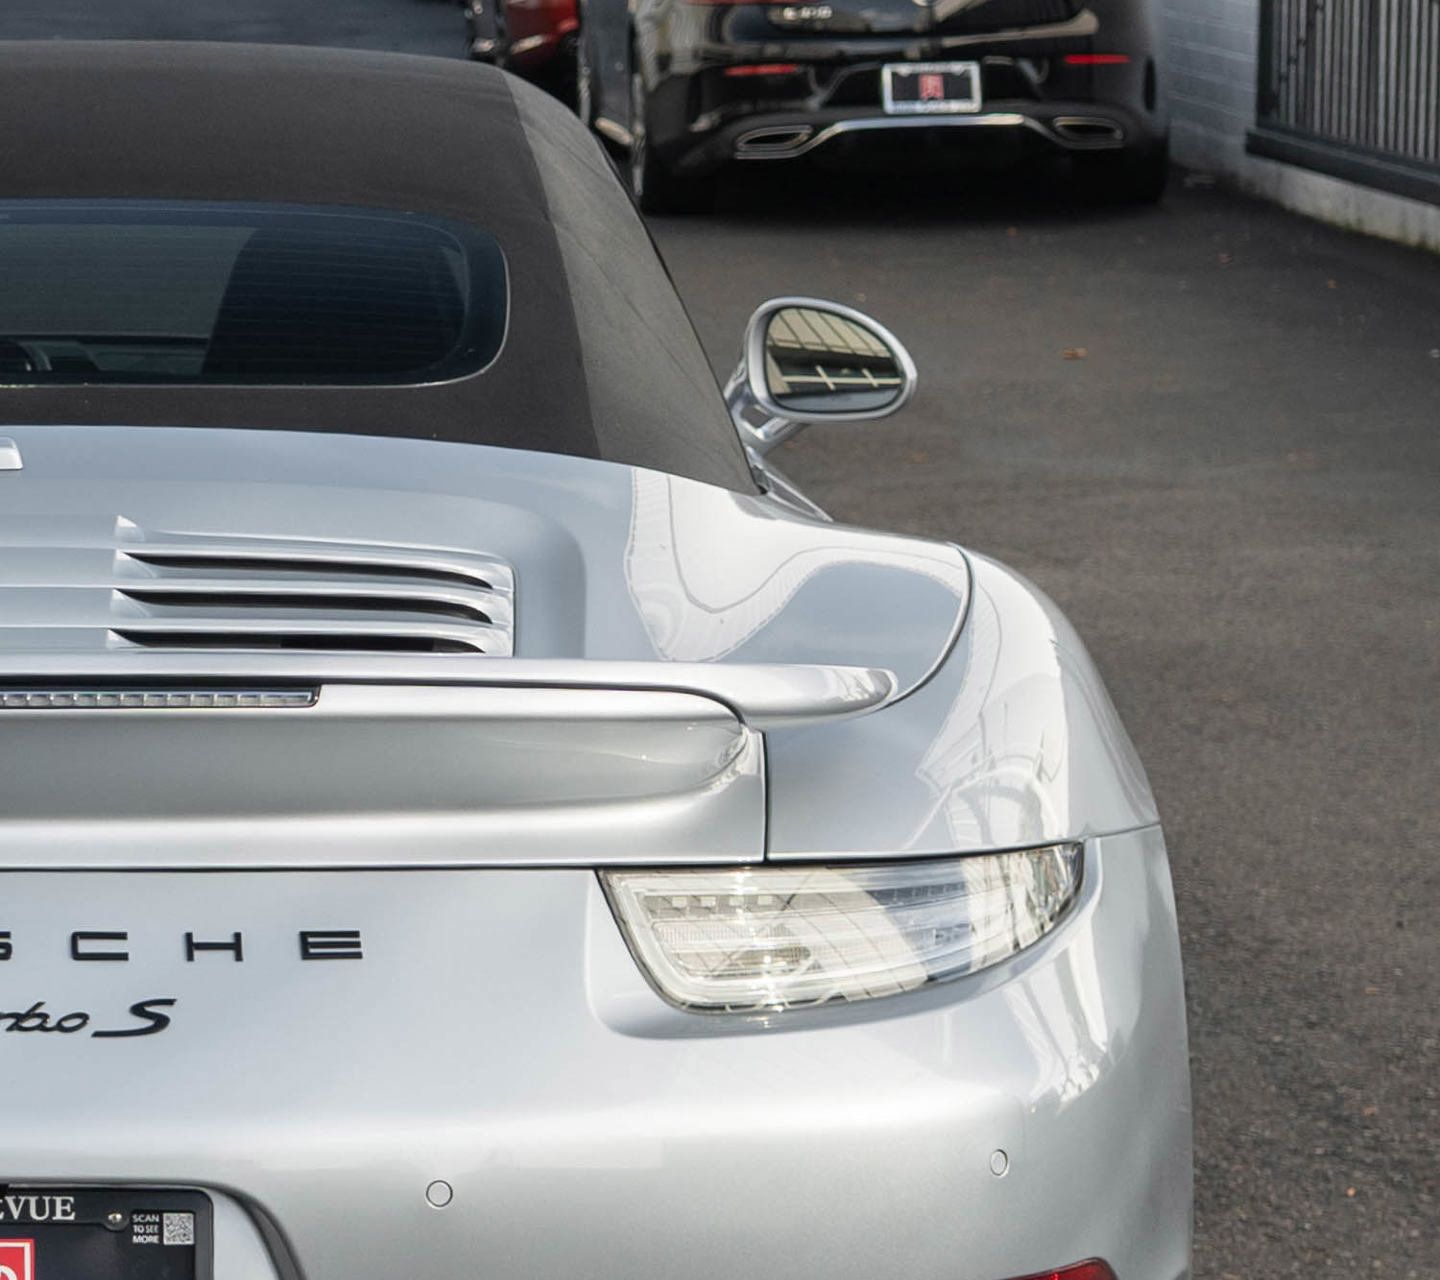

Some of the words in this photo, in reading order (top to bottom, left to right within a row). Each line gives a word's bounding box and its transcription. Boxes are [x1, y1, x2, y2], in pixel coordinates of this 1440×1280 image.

[91, 998, 177, 1038] S
[132, 1214, 159, 1223] SCAN
[133, 1224, 145, 1234] TO
[146, 1224, 159, 1234] SEE
[132, 1235, 160, 1244] MORE
